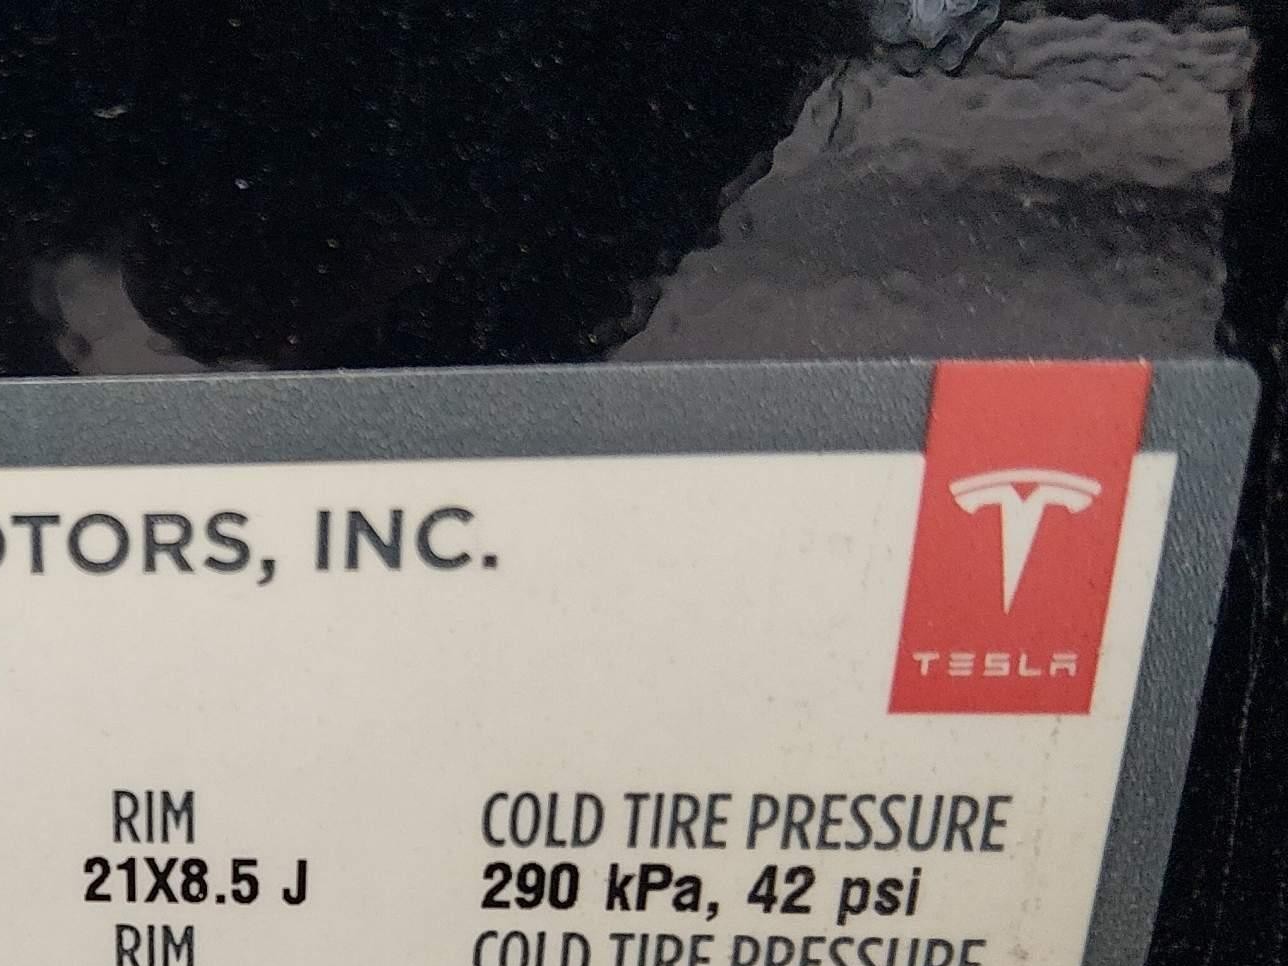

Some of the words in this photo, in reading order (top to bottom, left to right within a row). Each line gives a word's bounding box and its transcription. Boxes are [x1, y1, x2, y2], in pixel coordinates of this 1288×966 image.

[315, 506, 498, 572] INC.
[912, 651, 1078, 678] TESLA
[112, 789, 195, 845] RIM
[481, 790, 606, 849] COLD
[623, 791, 733, 850] TIRE
[745, 792, 1014, 853] PRESSURE
[83, 855, 260, 906] 21X8.5
[281, 858, 308, 907] J
[480, 860, 581, 911] 290
[604, 861, 720, 923] kPa,
[746, 863, 817, 915] 42
[835, 866, 923, 927] psi
